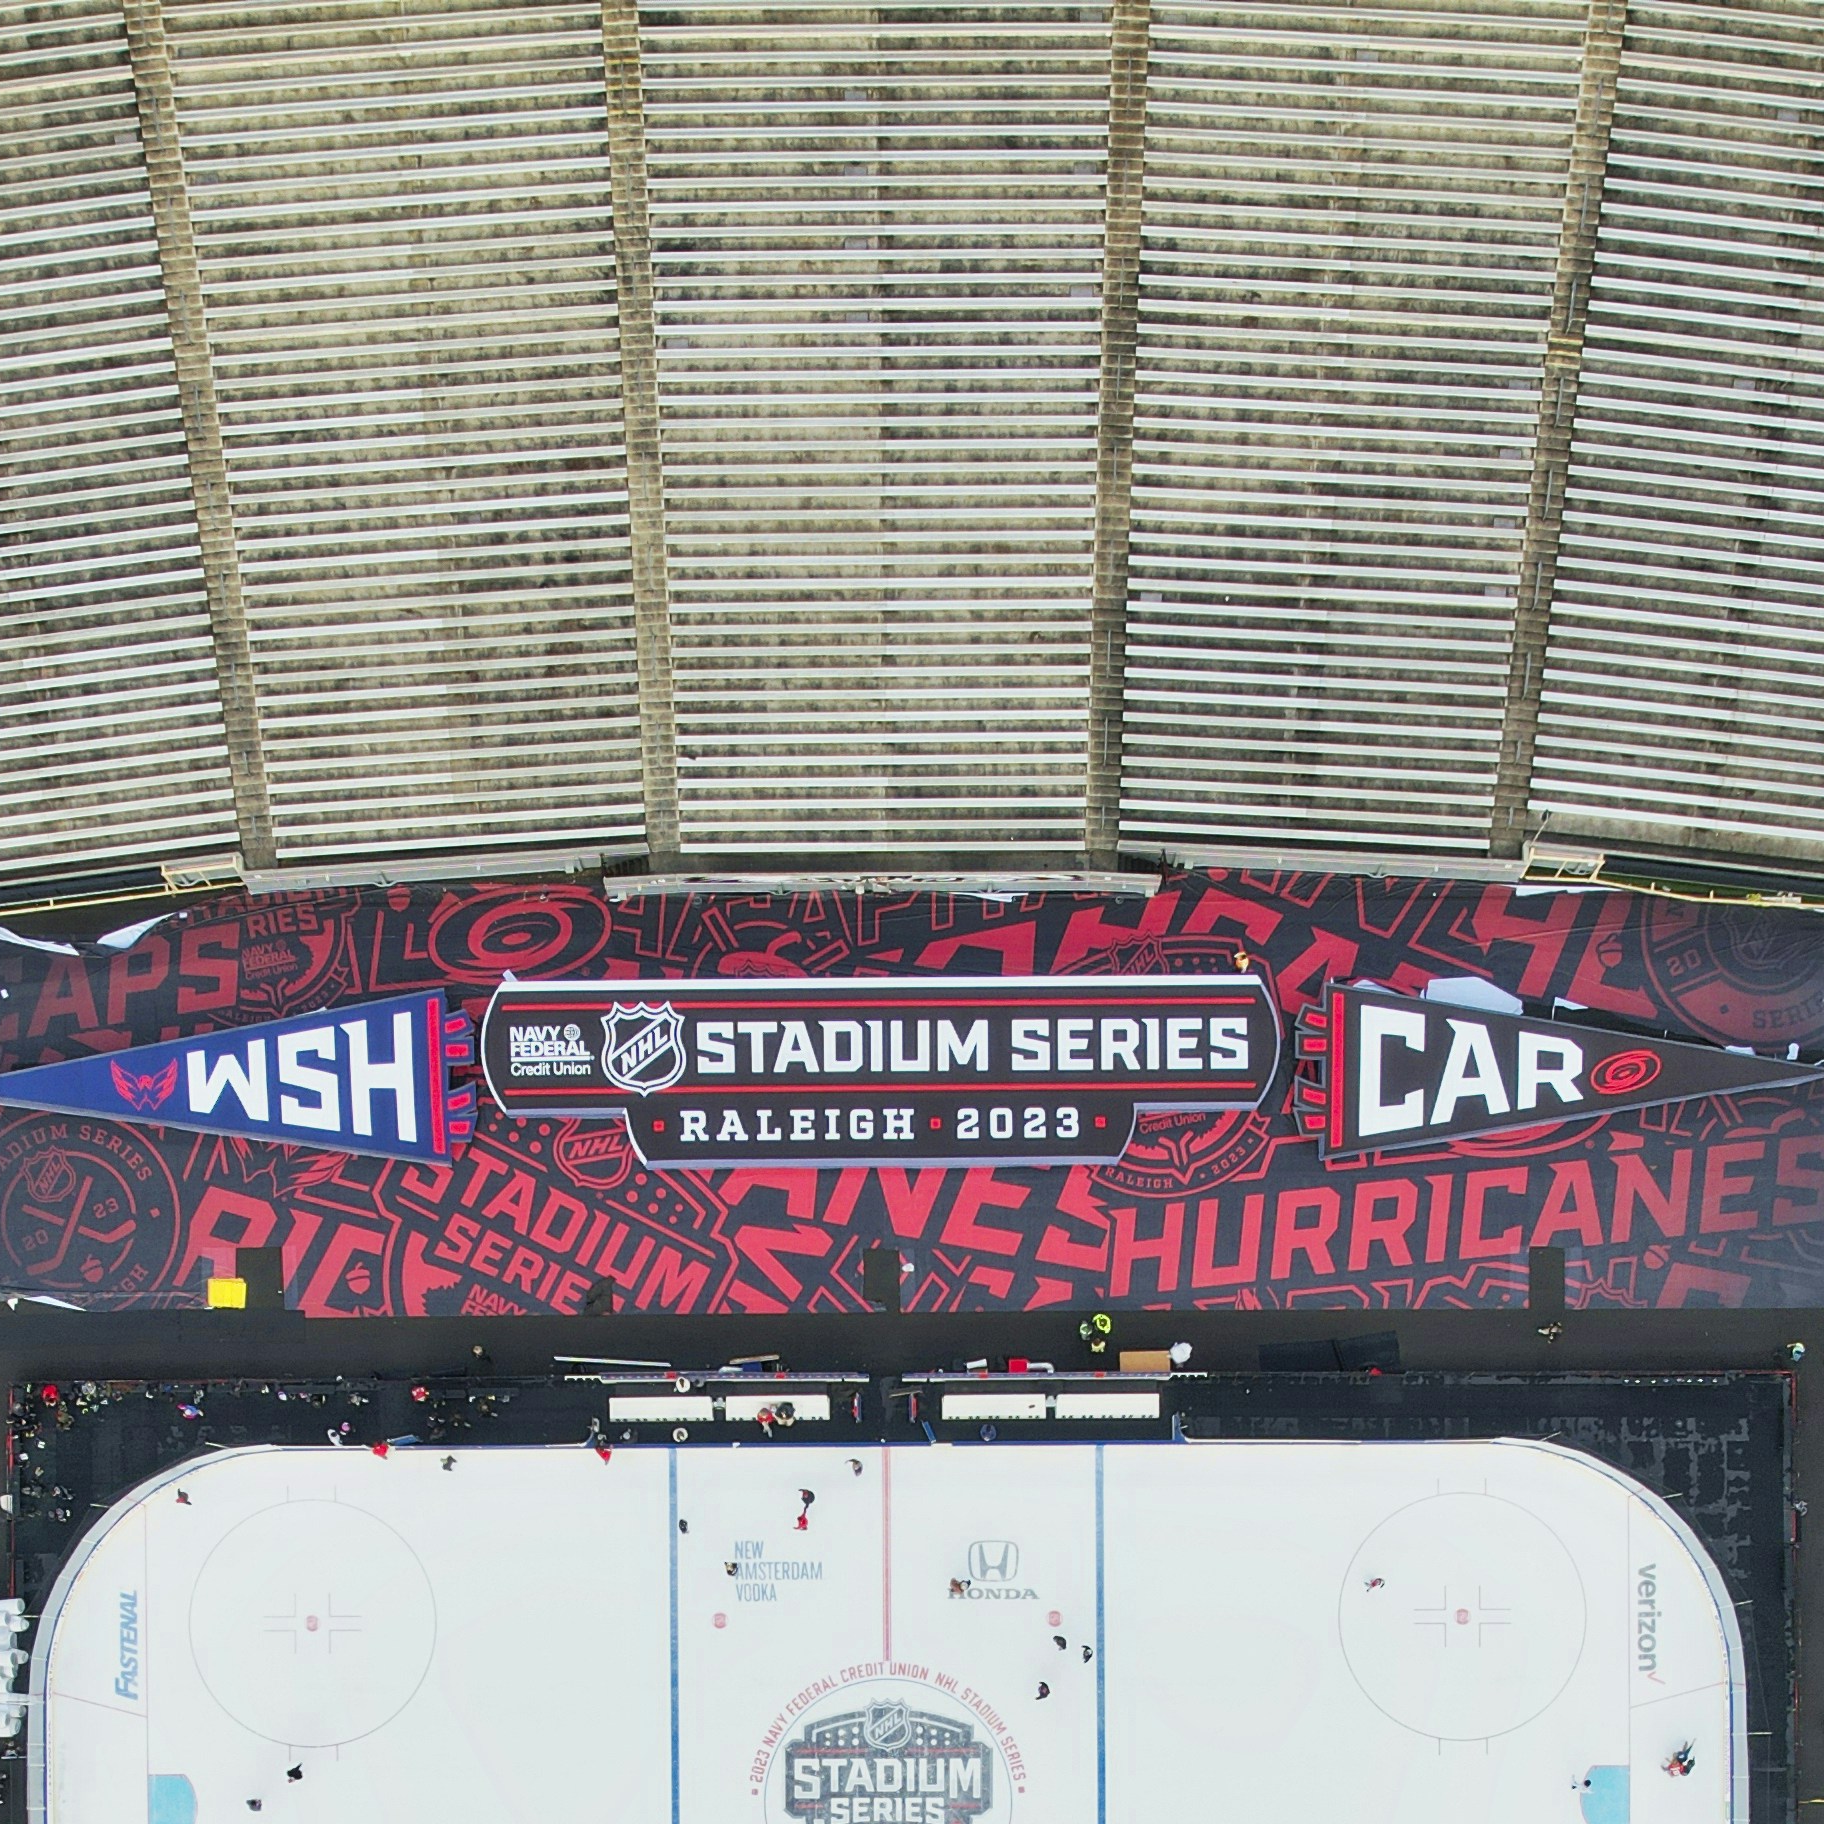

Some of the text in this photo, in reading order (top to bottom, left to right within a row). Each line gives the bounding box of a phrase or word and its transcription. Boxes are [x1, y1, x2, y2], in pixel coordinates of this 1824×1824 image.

[509, 1026, 560, 1042] NAVY
[509, 1040, 590, 1056] FEDERAL
[696, 1017, 1249, 1074] STADIUM SERIES
[619, 1026, 670, 1075] NHL
[186, 1009, 419, 1145] WSH
[510, 1061, 591, 1077] Credit Union
[1357, 1003, 1584, 1139] CAR
[679, 1107, 1080, 1142] RALEIGH 2023
[1139, 1111, 1207, 1135] Credit Union
[78, 1125, 153, 1182] SERIES
[567, 1130, 626, 1160] NHL
[38, 1161, 61, 1195] NHL
[1104, 1146, 1246, 1190] RALEIGH 2023
[93, 1196, 119, 1220] 23
[22, 1228, 49, 1251] 20
[734, 1540, 765, 1560] NEW
[734, 1561, 823, 1581] AMSTERDAM
[735, 1582, 777, 1602] VODKA
[947, 1587, 1040, 1600] HONDA
[1636, 1562, 1657, 1673] verizon
[750, 1661, 1027, 1784] 2023 NAVY FEDERAL CREDIT UNION NHL STADIUM SERIES
[875, 1713, 902, 1738] NHL
[793, 1757, 981, 1800] STADIUM
